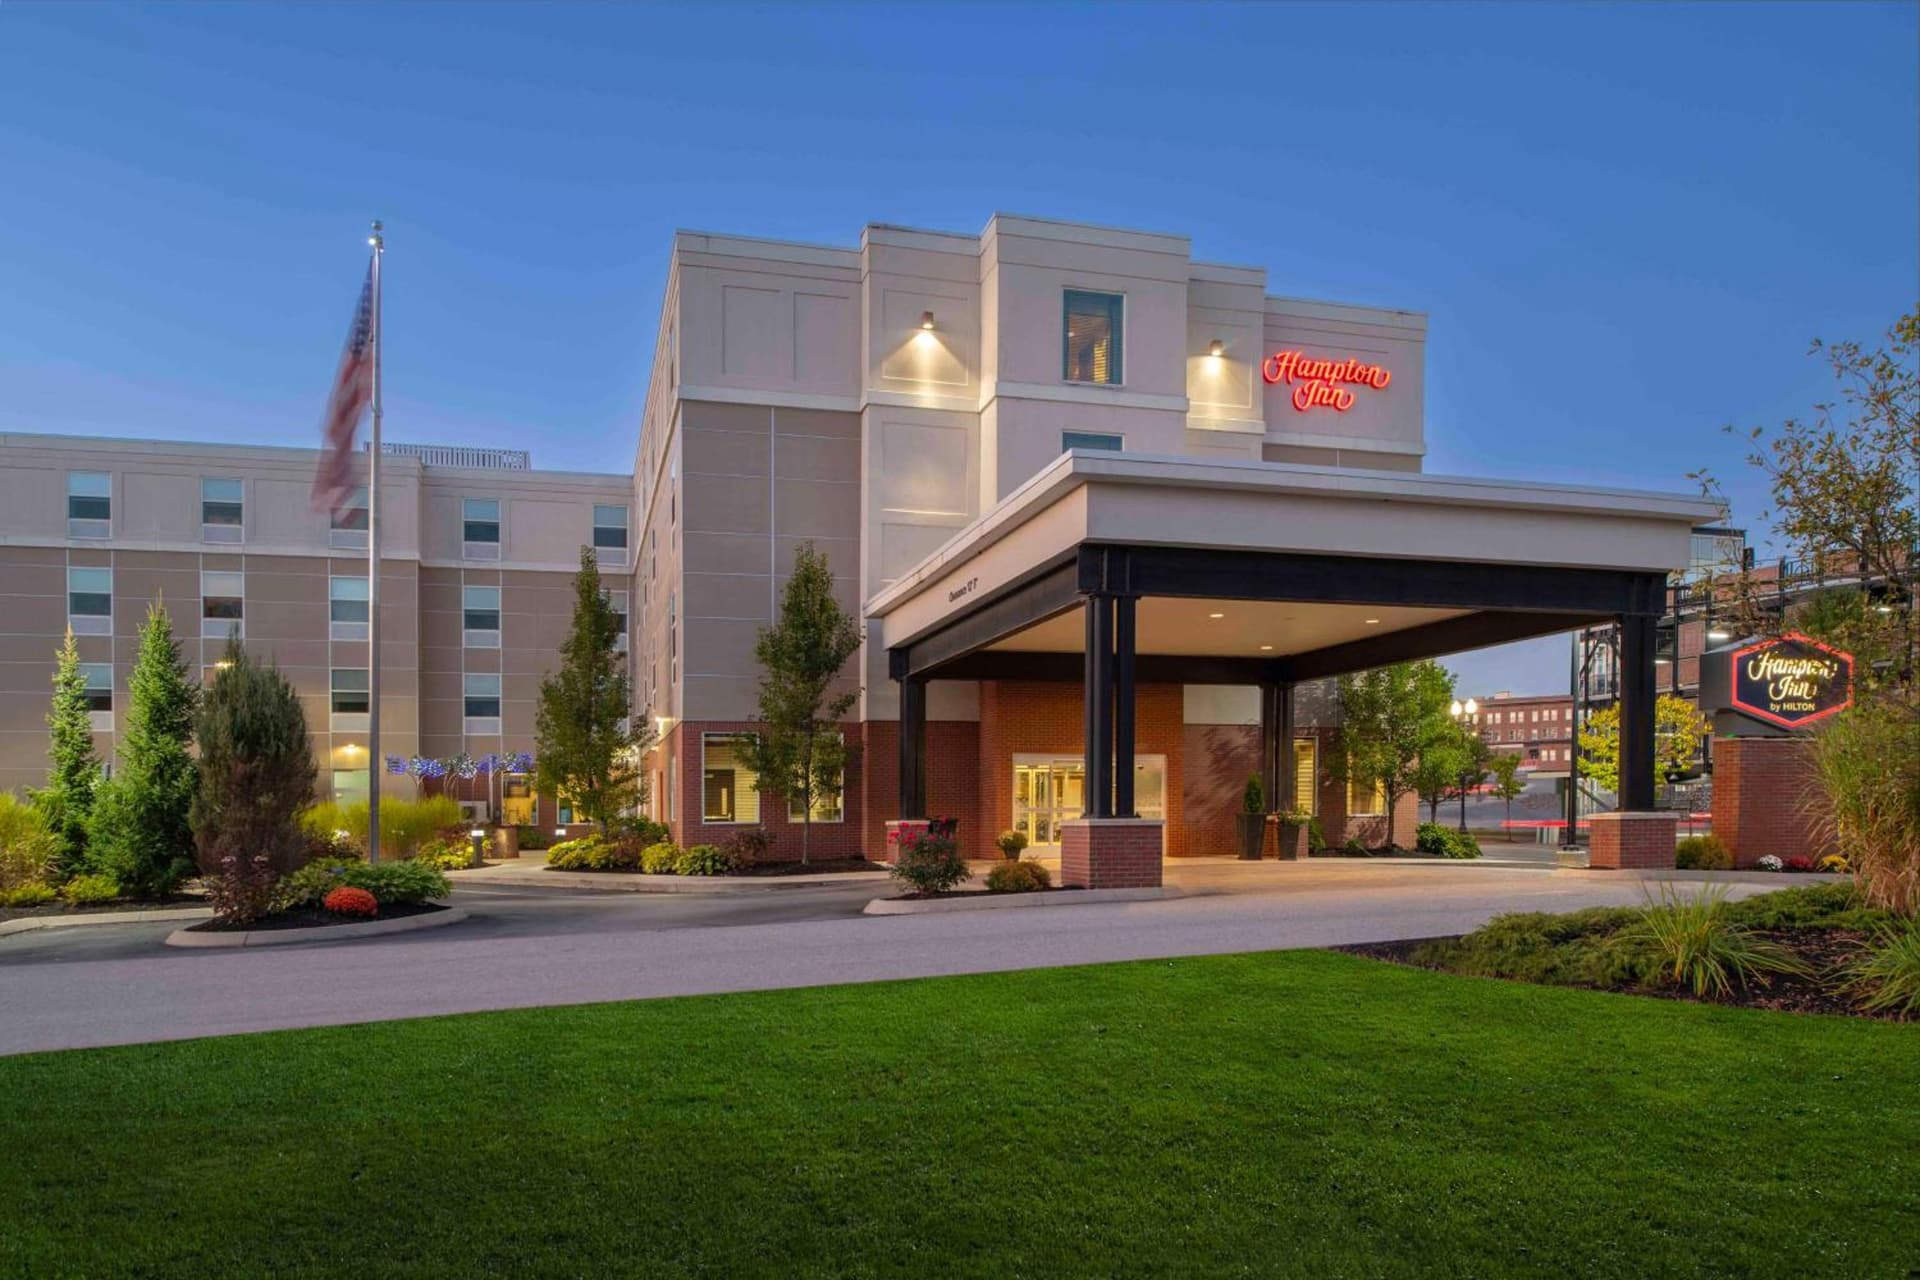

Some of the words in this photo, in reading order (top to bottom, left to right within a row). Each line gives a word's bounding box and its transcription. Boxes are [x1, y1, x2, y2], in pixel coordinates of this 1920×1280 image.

[1262, 350, 1391, 388] Hampton
[1292, 378, 1355, 412] Inn
[1768, 675, 1818, 701] Inn
[1769, 702, 1780, 713] by
[1782, 702, 1816, 712] HILTON
